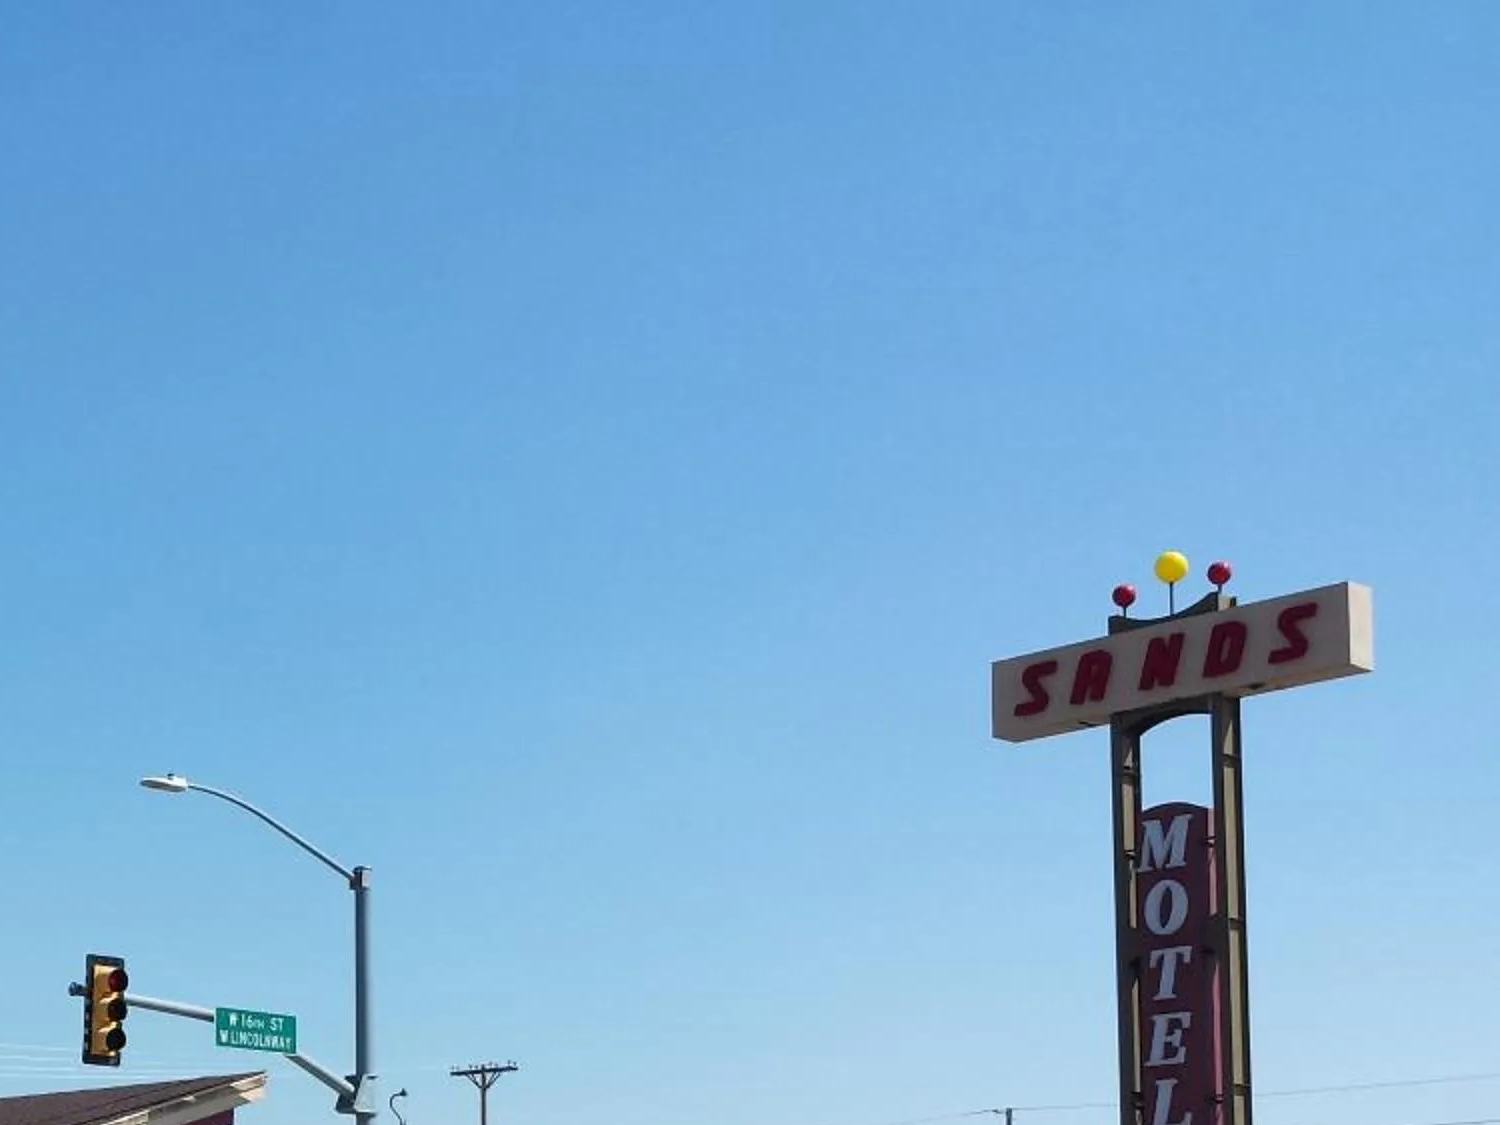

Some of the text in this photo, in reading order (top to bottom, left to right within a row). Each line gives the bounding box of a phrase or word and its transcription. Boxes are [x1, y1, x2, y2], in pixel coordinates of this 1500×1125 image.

[1014, 603, 1317, 716] SANDS
[229, 1012, 239, 1026] W
[269, 1017, 285, 1031] ST
[220, 1029, 293, 1050] W LINCOLNWAY
